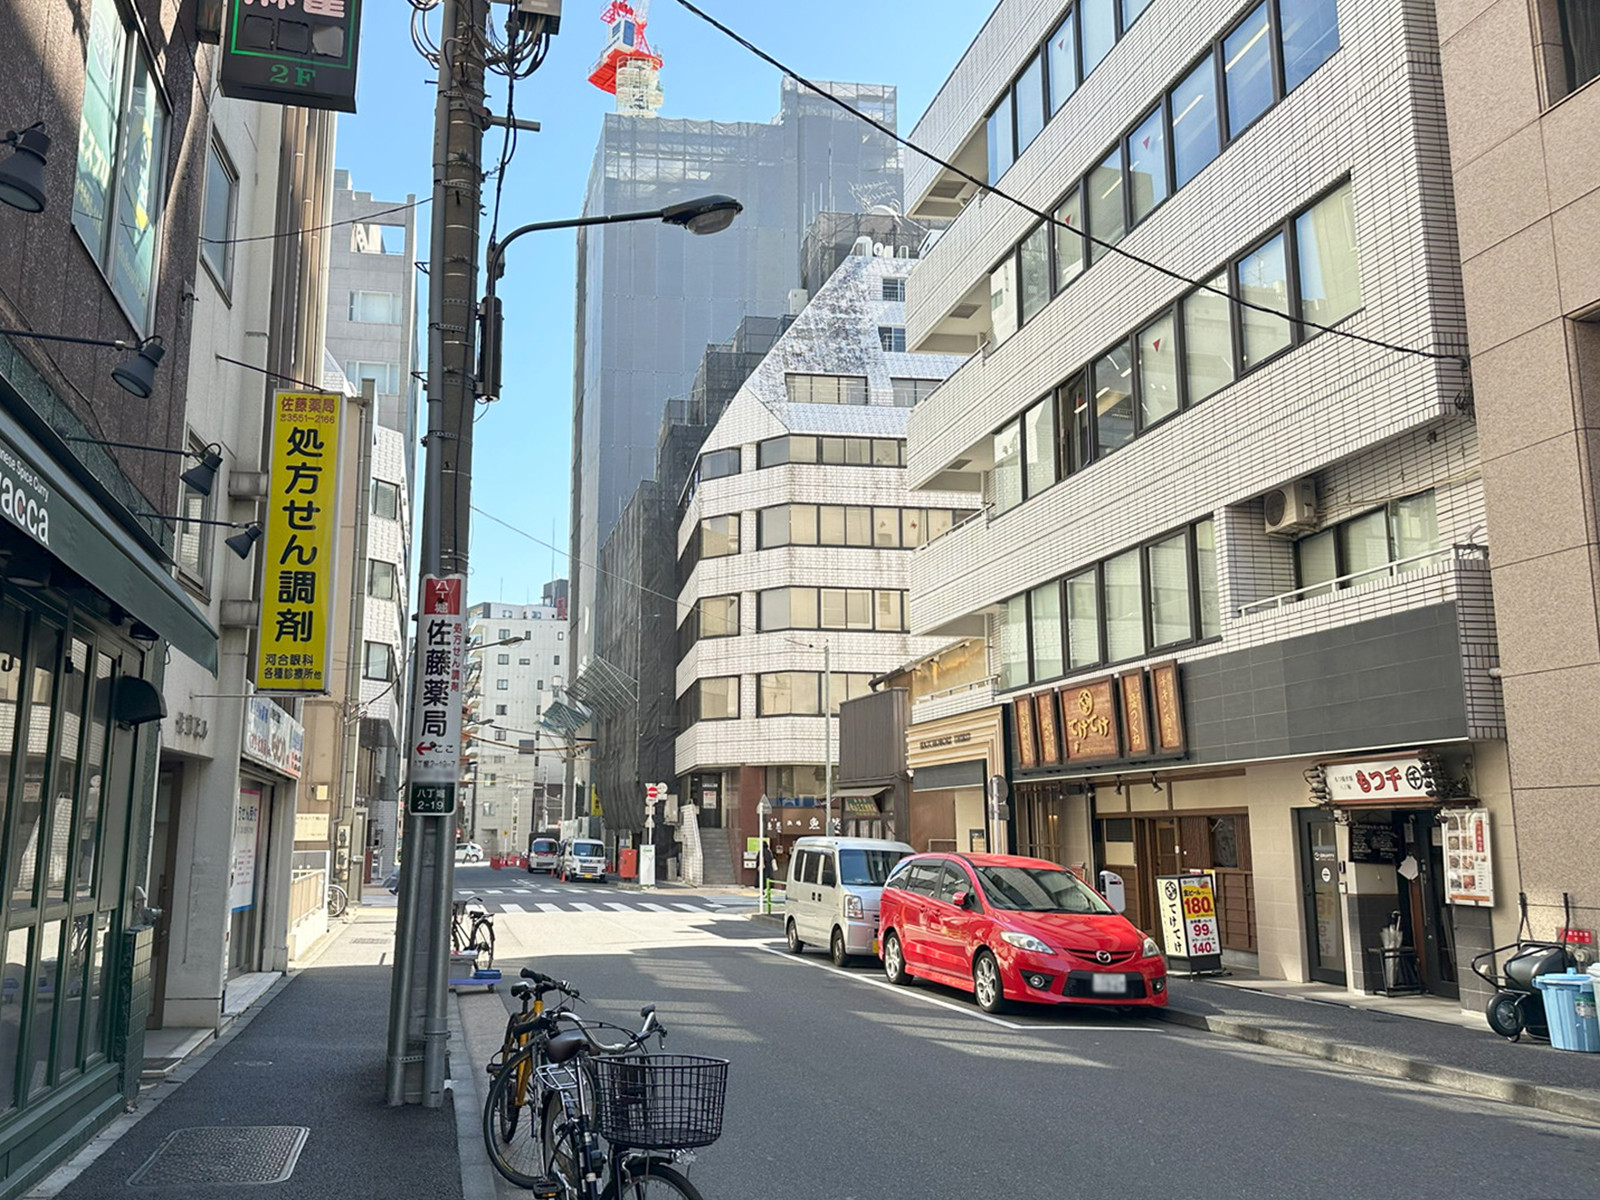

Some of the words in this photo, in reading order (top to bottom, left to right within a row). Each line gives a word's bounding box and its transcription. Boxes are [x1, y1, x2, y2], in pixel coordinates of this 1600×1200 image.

[270, 64, 316, 87] 2F
[281, 397, 335, 413] 佐藤薬局
[16, 460, 33, 487] Spice
[33, 476, 49, 503] Curry
[0, 471, 49, 546] acca
[275, 426, 325, 642] 処方せん調剤
[265, 653, 314, 666] 河合眼科
[450, 622, 463, 693] 処方せん調剤
[421, 619, 452, 737] 佐藤薬局
[1067, 714, 1110, 740] てけてけ
[434, 745, 454, 754] ここ
[1355, 766, 1402, 793] もつ千
[417, 789, 446, 798] 八丁堀
[417, 800, 444, 810] 2-19
[1184, 896, 1211, 914] 180
[1169, 903, 1182, 953] てけてけ
[1193, 923, 1210, 937] 99
[1193, 941, 1212, 954] 140
